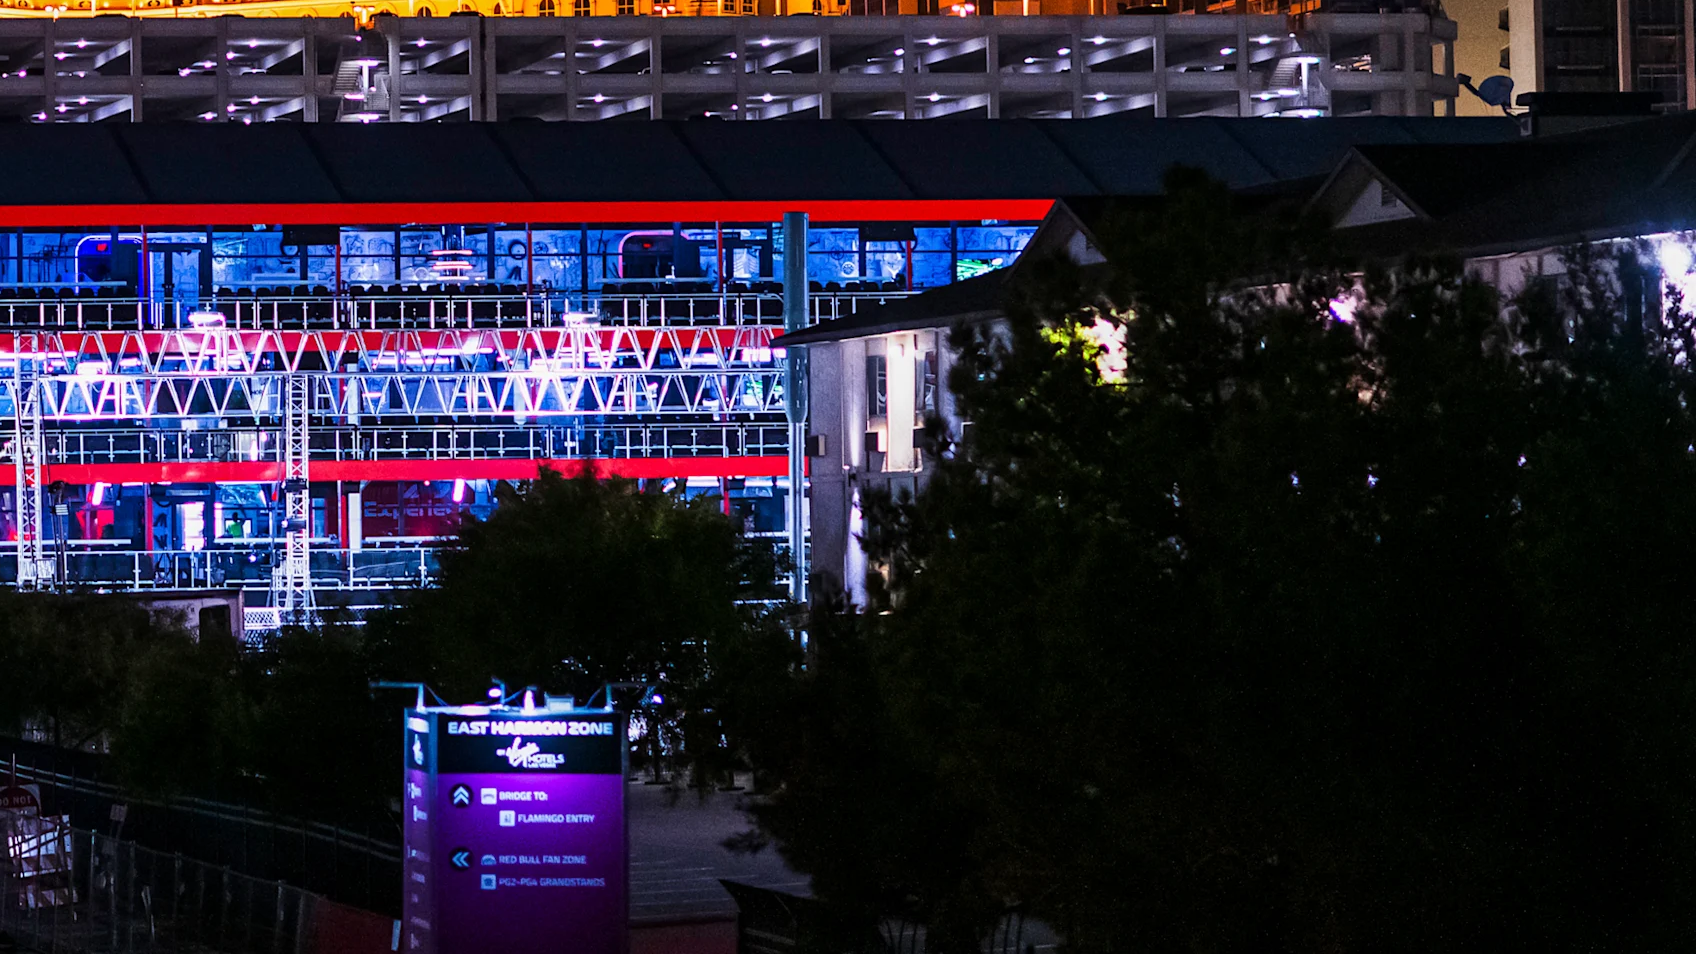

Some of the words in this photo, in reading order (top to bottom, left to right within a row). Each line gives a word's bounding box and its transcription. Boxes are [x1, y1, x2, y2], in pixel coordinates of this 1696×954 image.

[448, 722, 491, 735] EAST
[491, 721, 567, 736] HARMON
[568, 722, 613, 735] ZONE
[528, 754, 565, 764] HOTELS
[12, 795, 32, 805] NOT
[499, 791, 532, 801] BRIDGE
[533, 791, 548, 801] TO:
[517, 814, 564, 823] FLAMINGO
[565, 814, 595, 823] ENTRY
[499, 855, 517, 864] RED
[519, 855, 541, 864] BULL
[543, 855, 561, 864] FAN
[562, 855, 587, 864] ZONE
[539, 878, 605, 887] GRANDSTANDS
